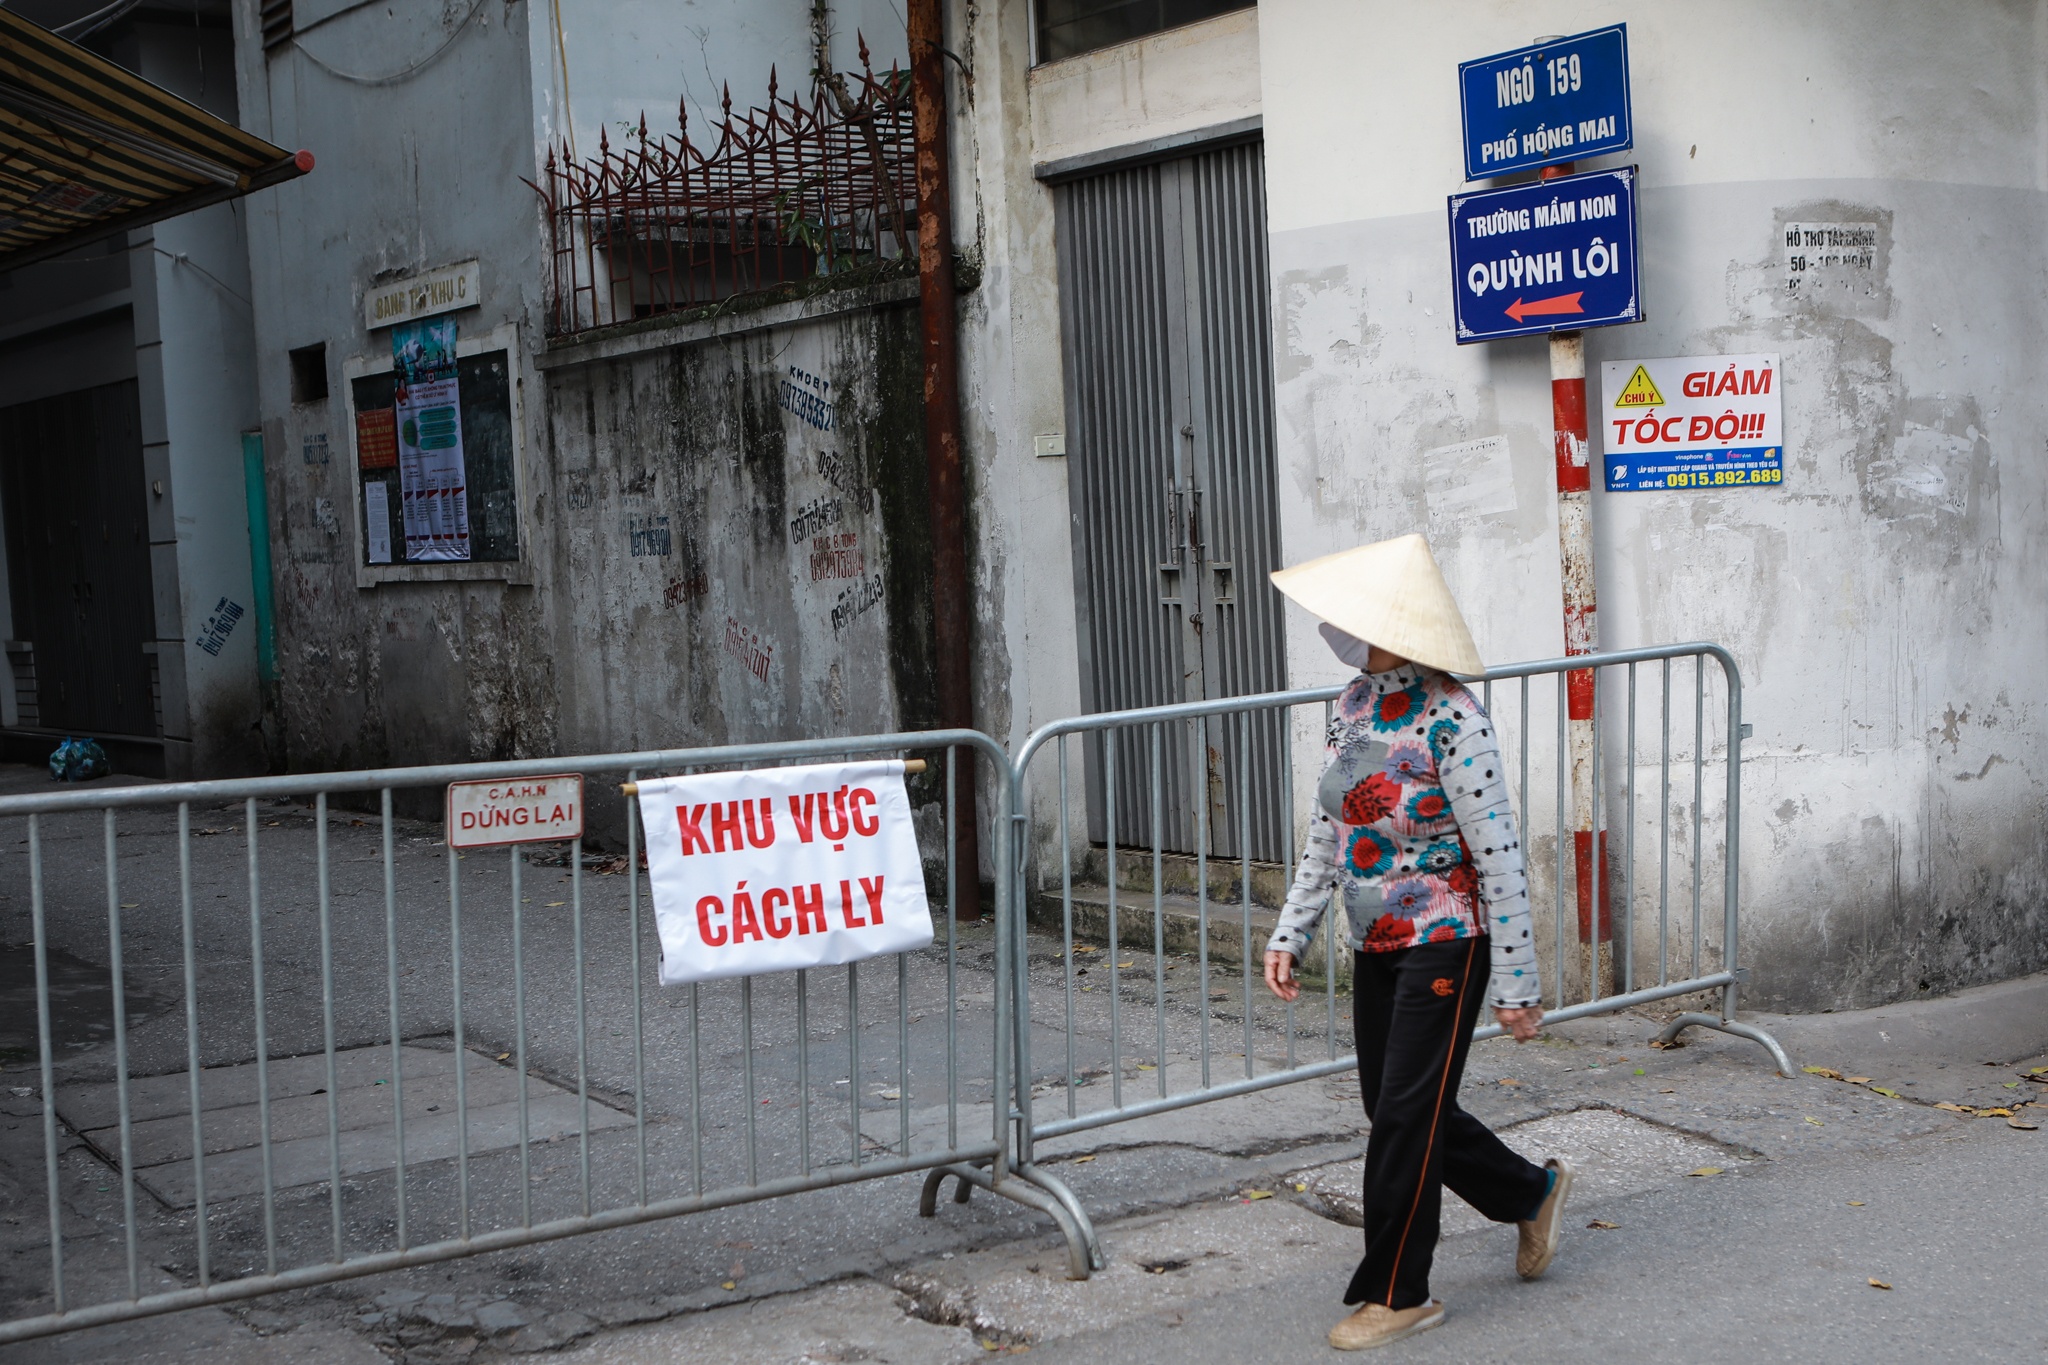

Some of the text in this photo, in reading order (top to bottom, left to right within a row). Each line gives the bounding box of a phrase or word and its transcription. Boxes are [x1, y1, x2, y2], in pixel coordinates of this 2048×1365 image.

[1496, 54, 1582, 108] NGÕ 159
[1482, 115, 1616, 164] PHỐ HỒNG MAI
[1467, 194, 1617, 239] TRƯỜNG MẦM NON
[1786, 224, 1800, 247] HỖ
[1467, 236, 1619, 297] QUỲNH LÔI
[1790, 255, 1805, 271] 50
[431, 279, 454, 306] KHU
[458, 275, 466, 299] C
[1625, 390, 1655, 403] CHÚ Ý
[1682, 363, 1772, 398] GIẢM
[1612, 408, 1766, 445] TỐC ĐỘ!!!
[1639, 469, 1782, 488] LIÊN HỆ: 0915.892.689
[1657, 465, 1680, 473] INTERNET
[1681, 463, 1691, 472] CÁP
[1691, 464, 1707, 472] QUANG
[1708, 463, 1715, 471] VÀ
[1715, 462, 1733, 470] TRUYỀN
[1746, 461, 1758, 469] THEO
[488, 784, 547, 799] C.A.H.N
[461, 802, 573, 830] DỪNG LẠI
[676, 784, 880, 857] KHU VỰC
[696, 875, 886, 948] CÁCH LY
